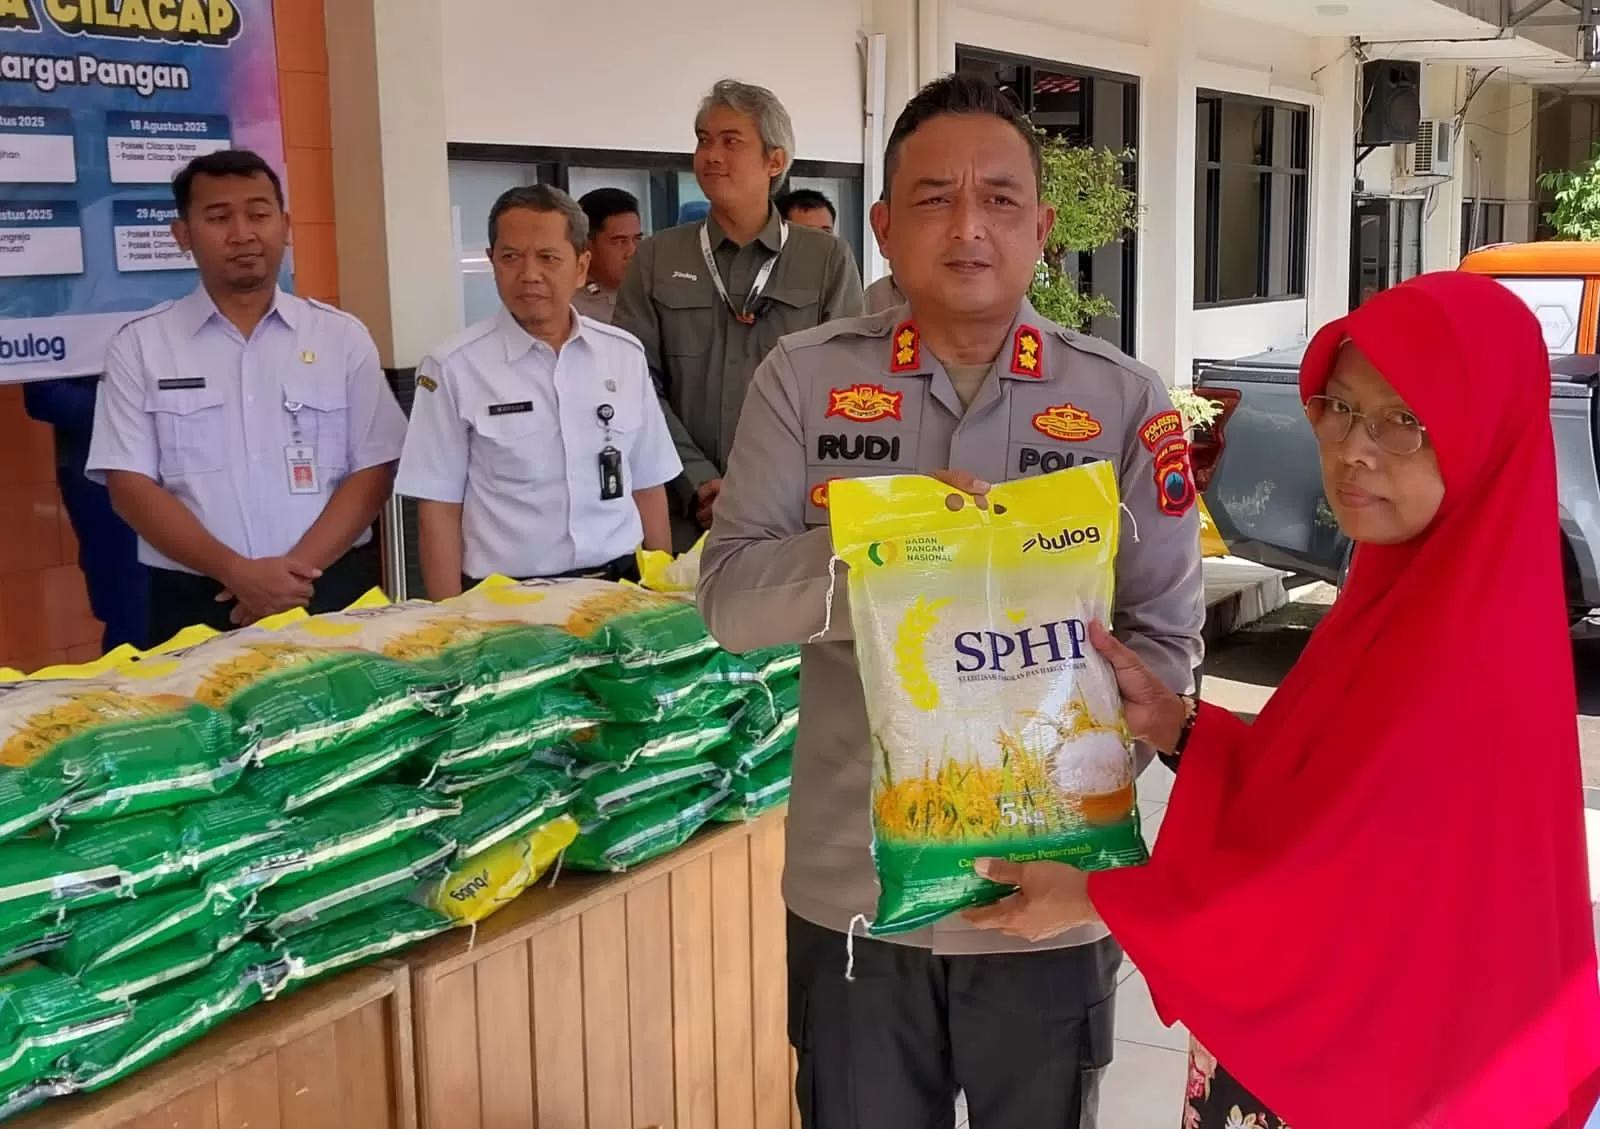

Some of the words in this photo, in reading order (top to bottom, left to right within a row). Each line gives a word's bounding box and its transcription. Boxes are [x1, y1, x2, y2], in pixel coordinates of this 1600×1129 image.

[46, 0, 234, 36] CILACAP
[0, 56, 74, 91] arga
[80, 57, 189, 95] Pangan
[18, 116, 45, 128] 2025
[143, 121, 184, 134] Agustus
[184, 121, 208, 133] 2025
[146, 142, 175, 152] Cilacap
[147, 152, 176, 162] Cilacap
[26, 208, 53, 220] 2025
[136, 208, 148, 219] 29
[149, 208, 179, 222] Agust
[0, 331, 66, 361] bulog
[818, 434, 900, 461] RUDI
[1019, 448, 1107, 474] POL
[1037, 526, 1100, 551] bulog
[906, 545, 944, 553] PANGAN
[907, 553, 952, 562] NASIONAL
[954, 618, 1086, 673] SPHP
[1001, 802, 1018, 827] 5
[1038, 844, 1092, 859] Pemerintah
[450, 875, 489, 901] bulog
